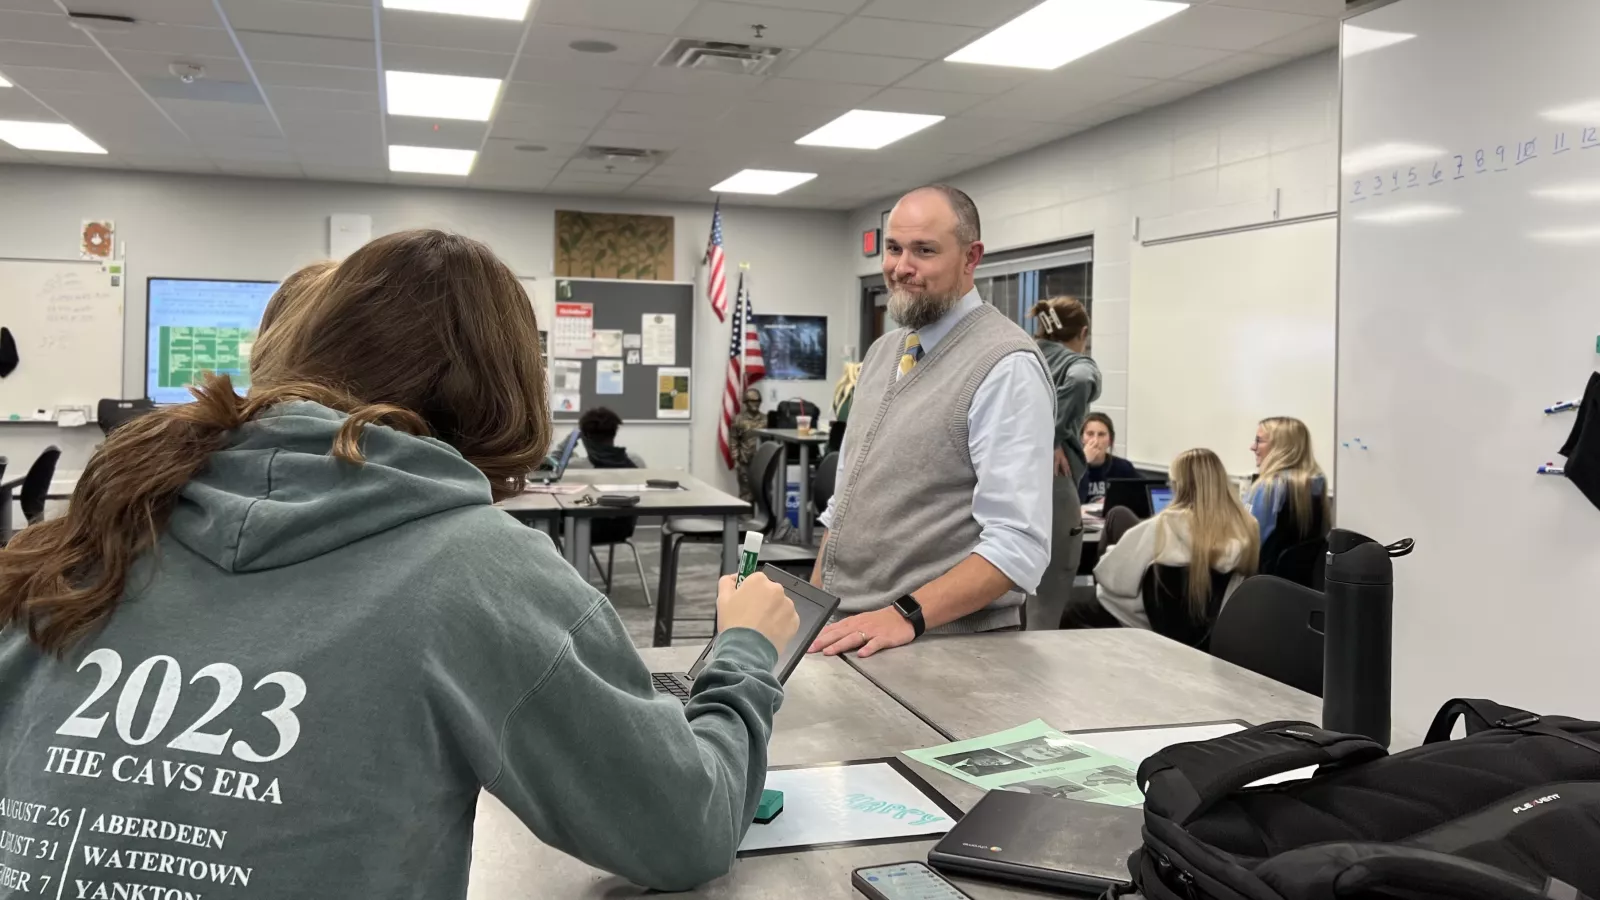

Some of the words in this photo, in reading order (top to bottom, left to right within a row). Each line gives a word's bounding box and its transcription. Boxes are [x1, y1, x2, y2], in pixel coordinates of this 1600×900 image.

[1353, 180, 1362, 196] 2
[1373, 175, 1383, 190] 3
[1392, 169, 1399, 186] 4
[1408, 166, 1418, 183] 5
[1432, 161, 1442, 180] 6
[1453, 155, 1463, 175] 7
[1475, 149, 1484, 167] 8
[1495, 145, 1505, 163] 9
[1554, 132, 1565, 151] 11
[1581, 127, 1597, 144] 12
[55, 648, 307, 763] 2023
[43, 746, 107, 779] THE
[111, 755, 206, 792] CAVS
[209, 768, 284, 805] ERA
[46, 806, 73, 829] 26
[89, 813, 229, 851] ABERDEEN
[35, 839, 60, 861] 31
[82, 844, 254, 887] WATERTOWN
[39, 874, 52, 895] 7
